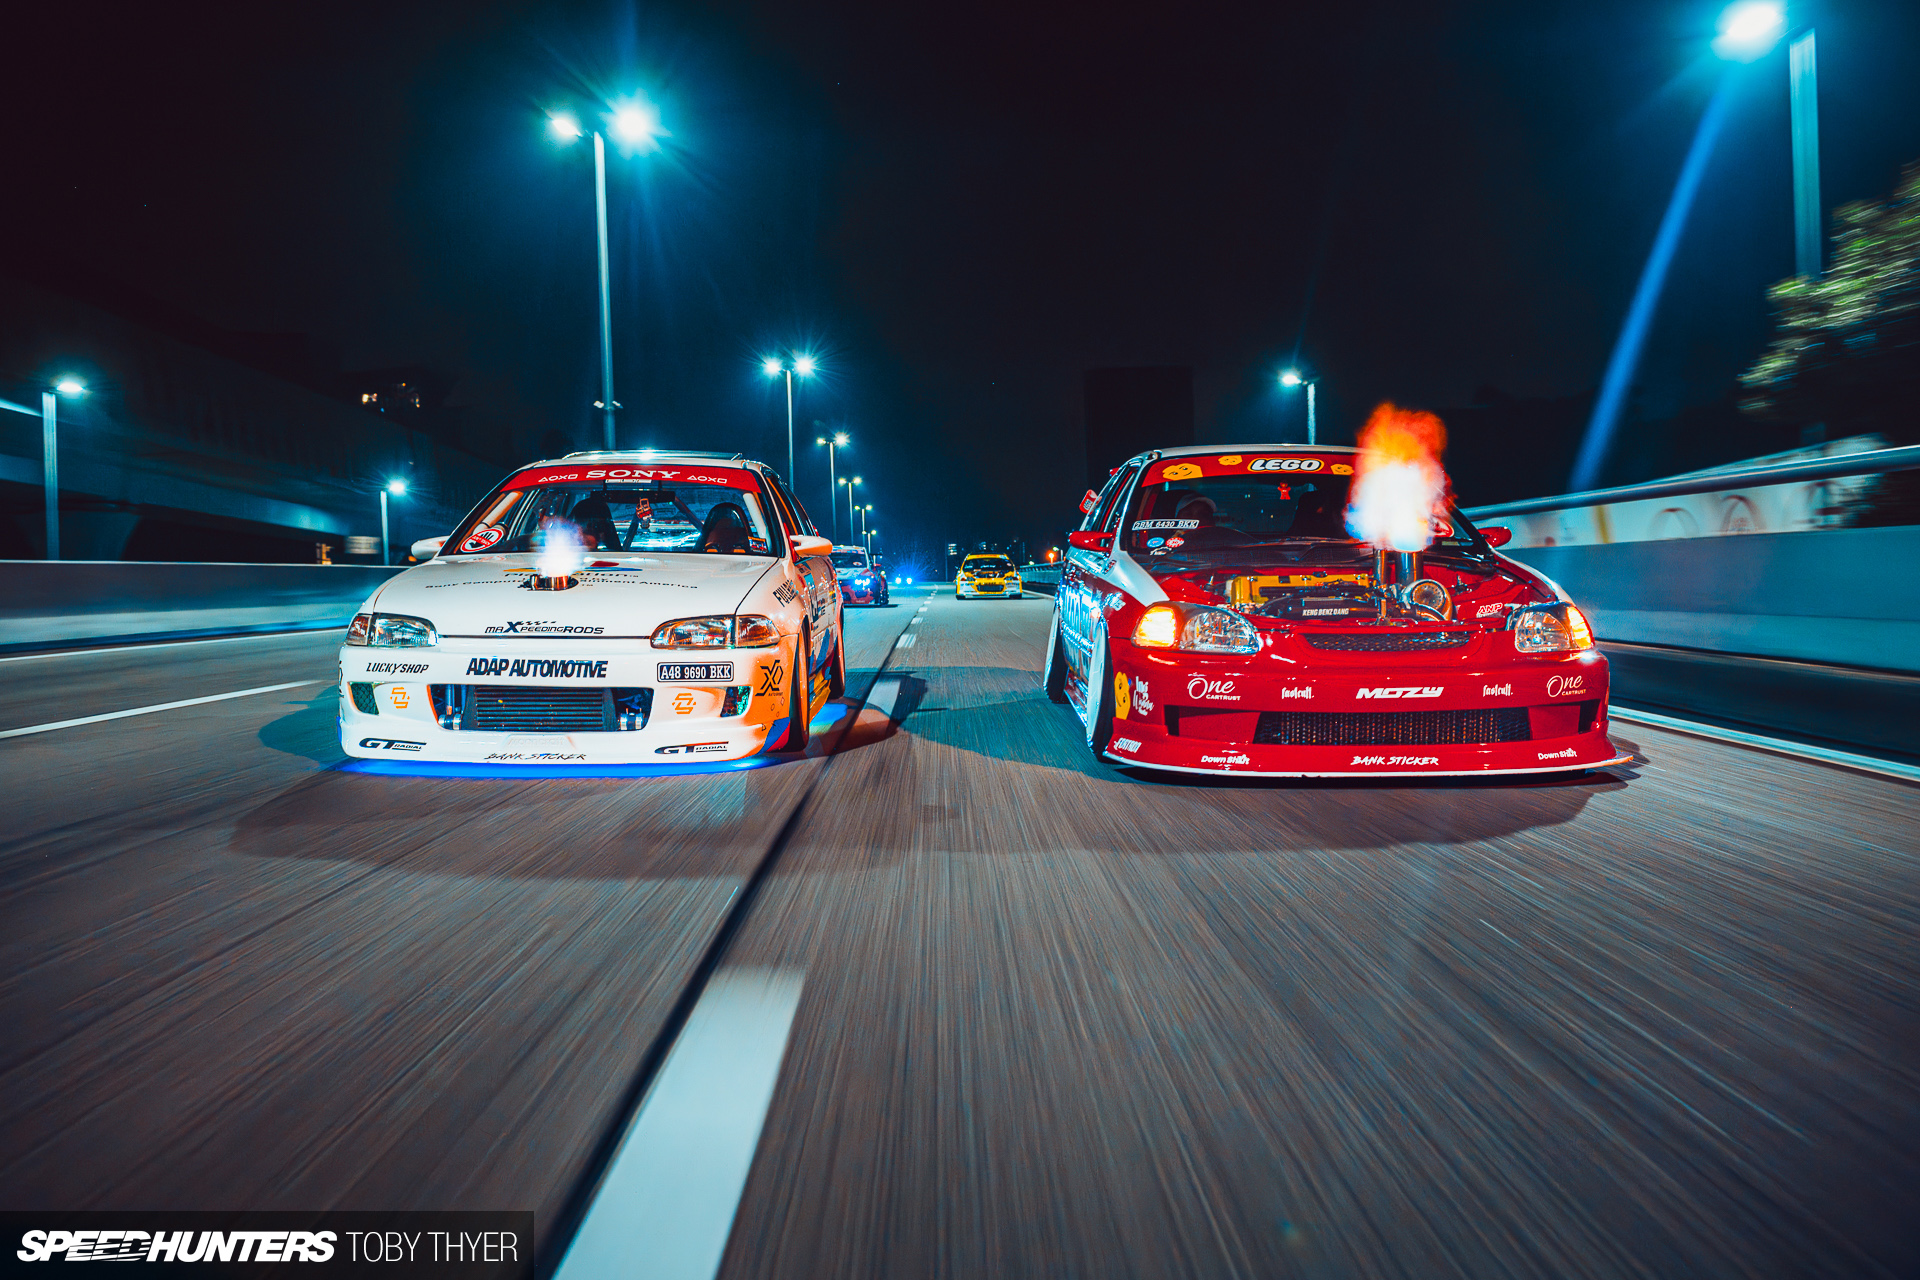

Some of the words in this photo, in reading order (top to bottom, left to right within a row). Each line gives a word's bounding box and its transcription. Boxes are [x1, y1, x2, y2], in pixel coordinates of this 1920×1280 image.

[1251, 458, 1321, 471] LEGO
[586, 469, 681, 479] SONY
[465, 657, 509, 676] ADAP
[508, 659, 609, 679] AUTOMOTIVE
[660, 665, 682, 679] A48
[684, 665, 706, 679] 9690
[709, 665, 731, 679] BKK
[1187, 677, 1235, 699] One
[1355, 686, 1445, 699] MOZY
[1546, 675, 1583, 697] One
[1206, 693, 1241, 701] CARTRUST
[1201, 755, 1227, 764] Down
[1351, 755, 1386, 765] BANK
[1387, 755, 1440, 766] STICKER
[1538, 752, 1559, 760] Down
